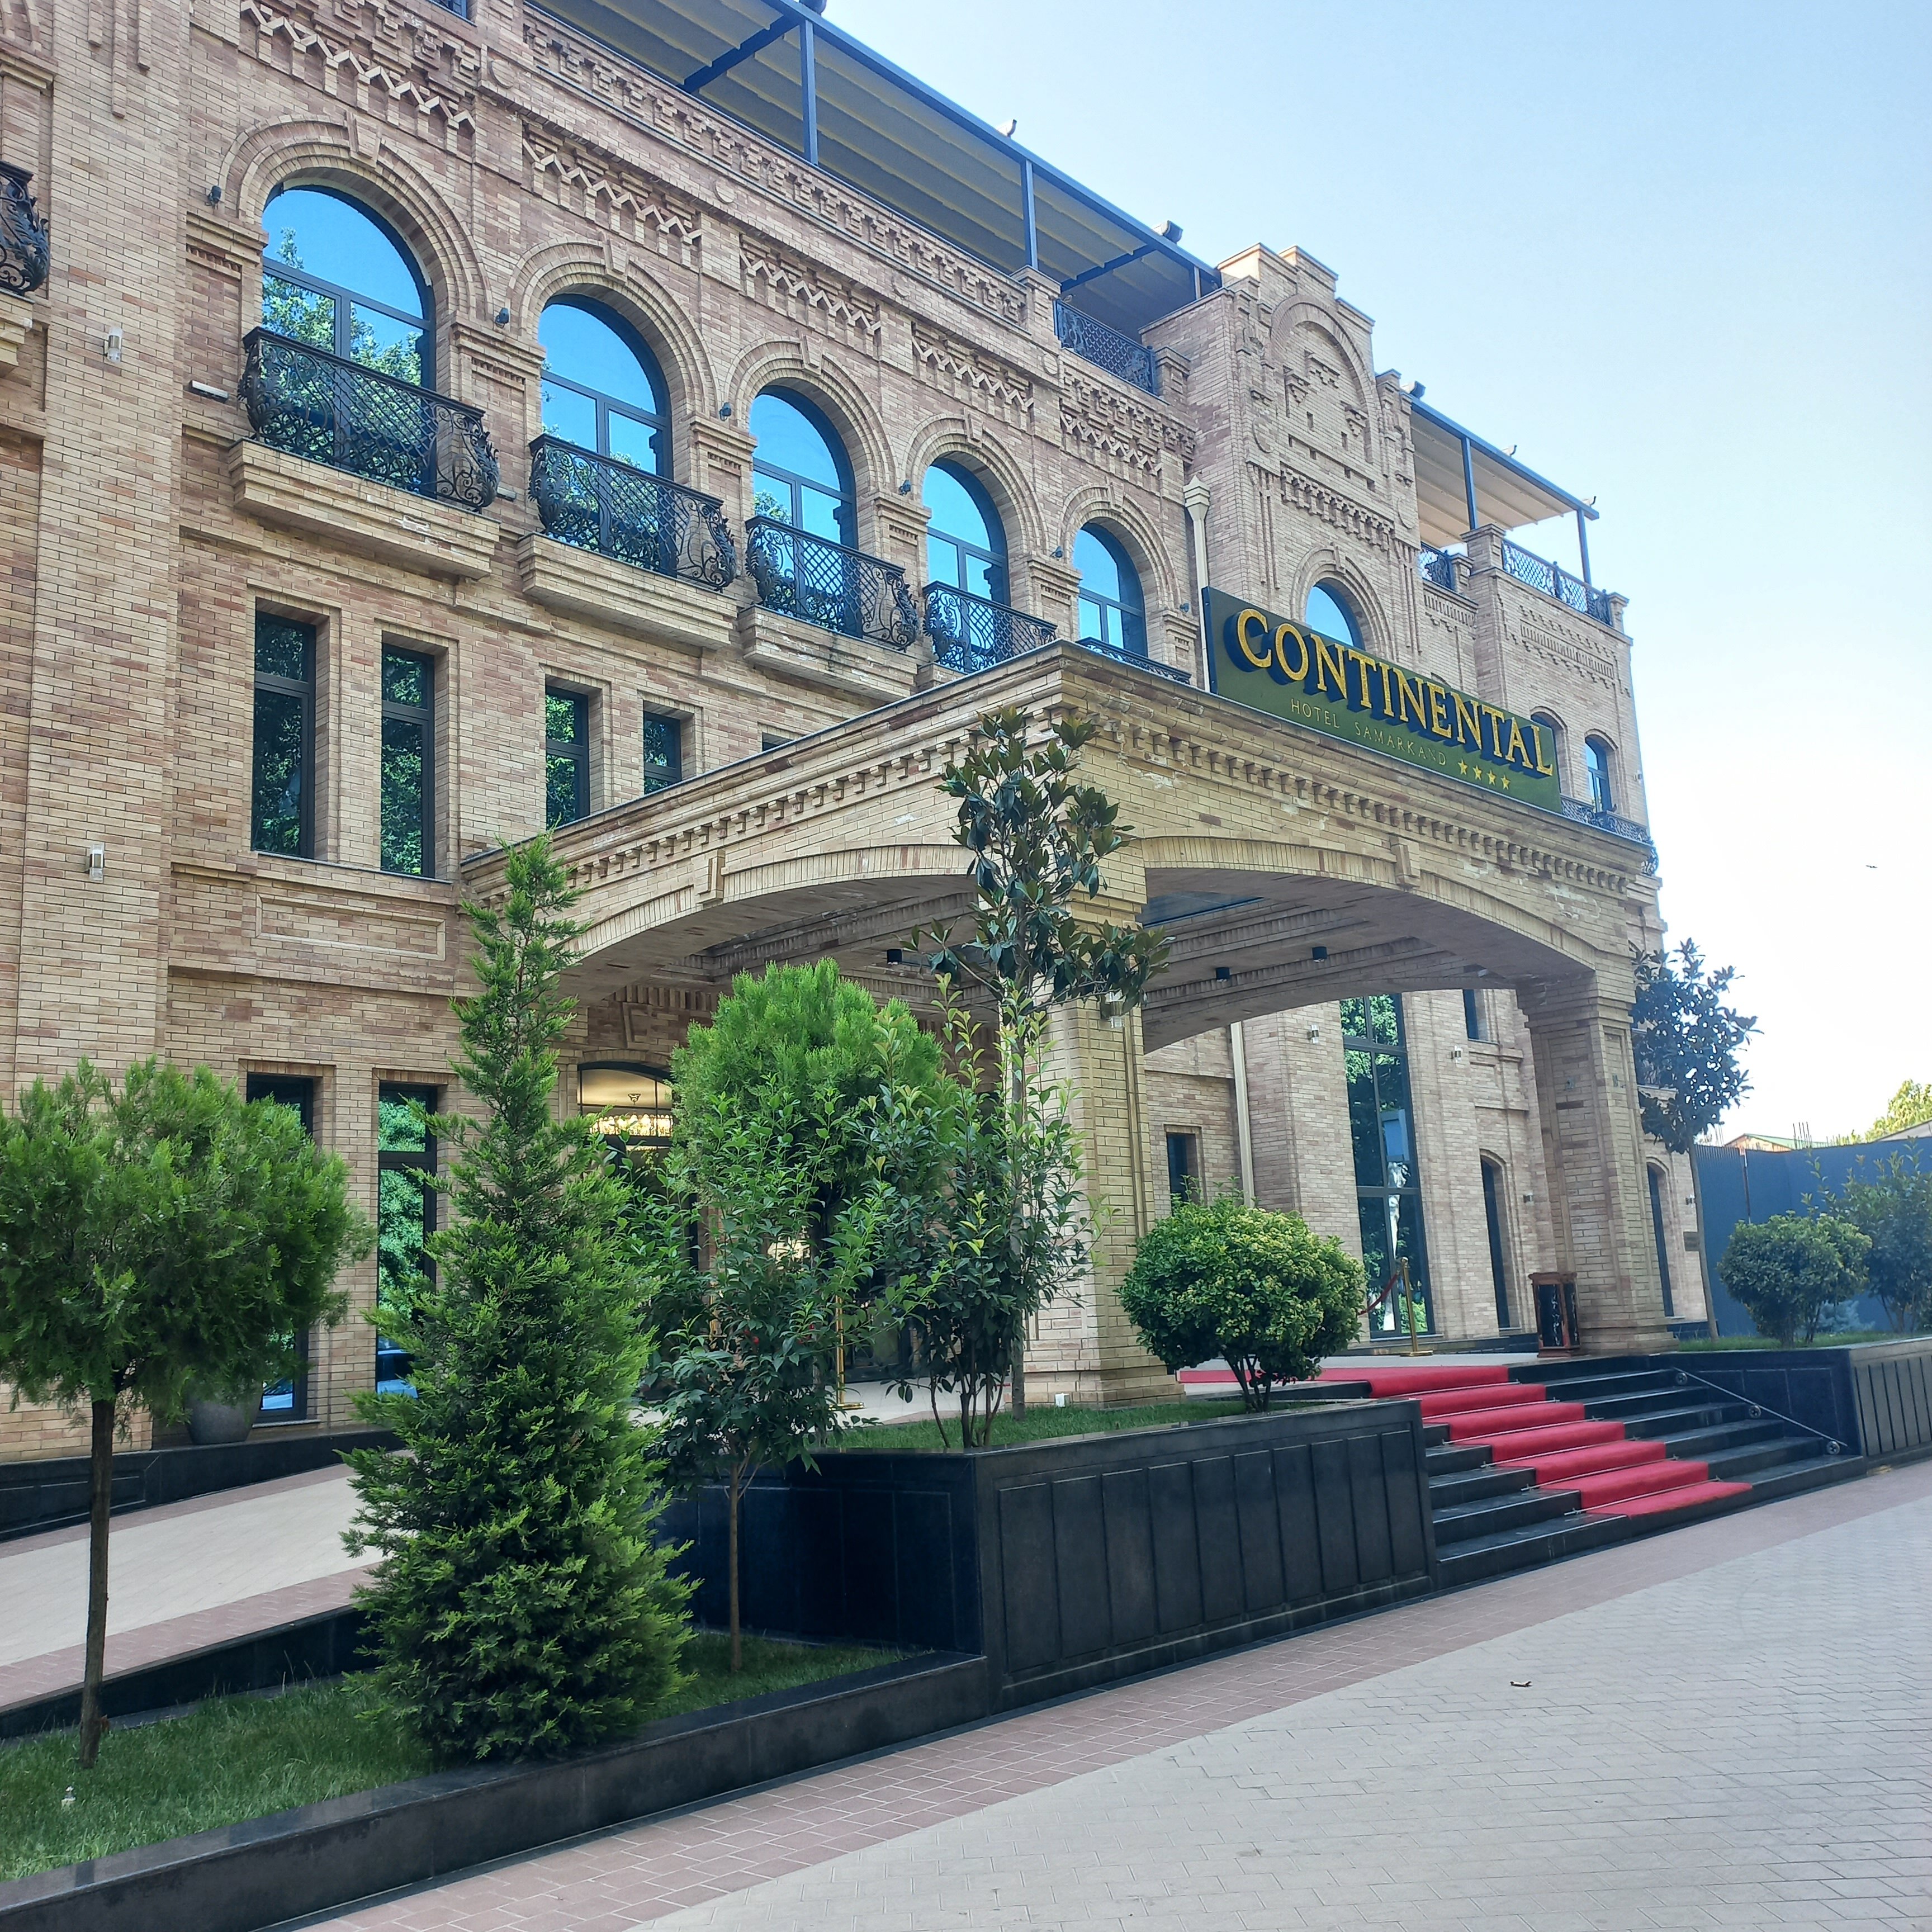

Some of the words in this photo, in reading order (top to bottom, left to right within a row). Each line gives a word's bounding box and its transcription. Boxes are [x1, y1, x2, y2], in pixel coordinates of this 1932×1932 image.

[1237, 608, 1554, 776] CONTINENTAL
[1290, 698, 1340, 729] HOTEL
[1354, 721, 1447, 766] SAMARKAND
